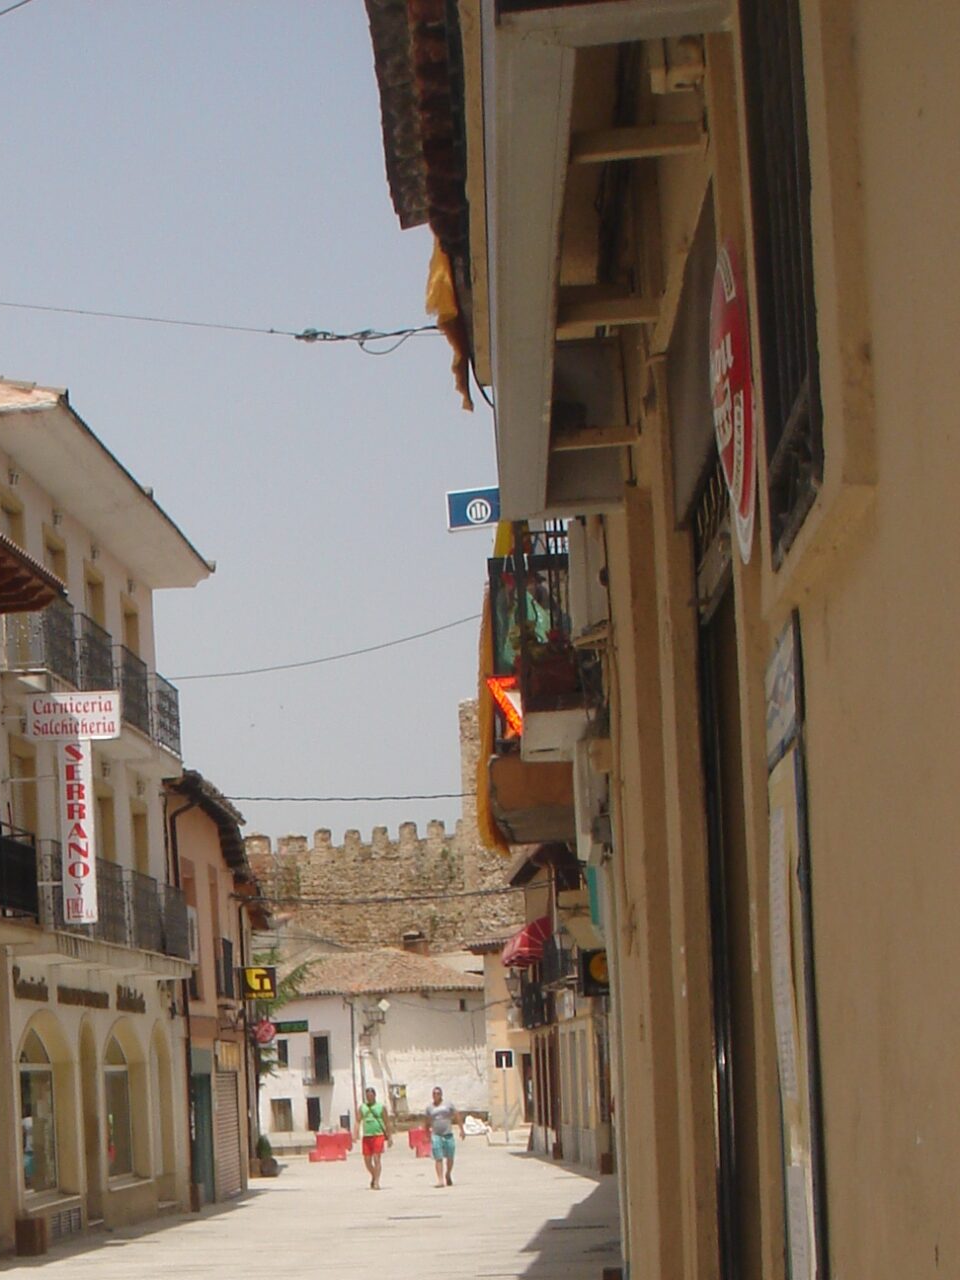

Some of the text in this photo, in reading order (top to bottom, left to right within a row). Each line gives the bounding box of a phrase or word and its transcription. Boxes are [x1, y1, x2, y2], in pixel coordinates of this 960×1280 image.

[32, 695, 113, 716] Carniceria
[32, 716, 116, 736] Salchicheria
[64, 743, 90, 878] SERRANO
